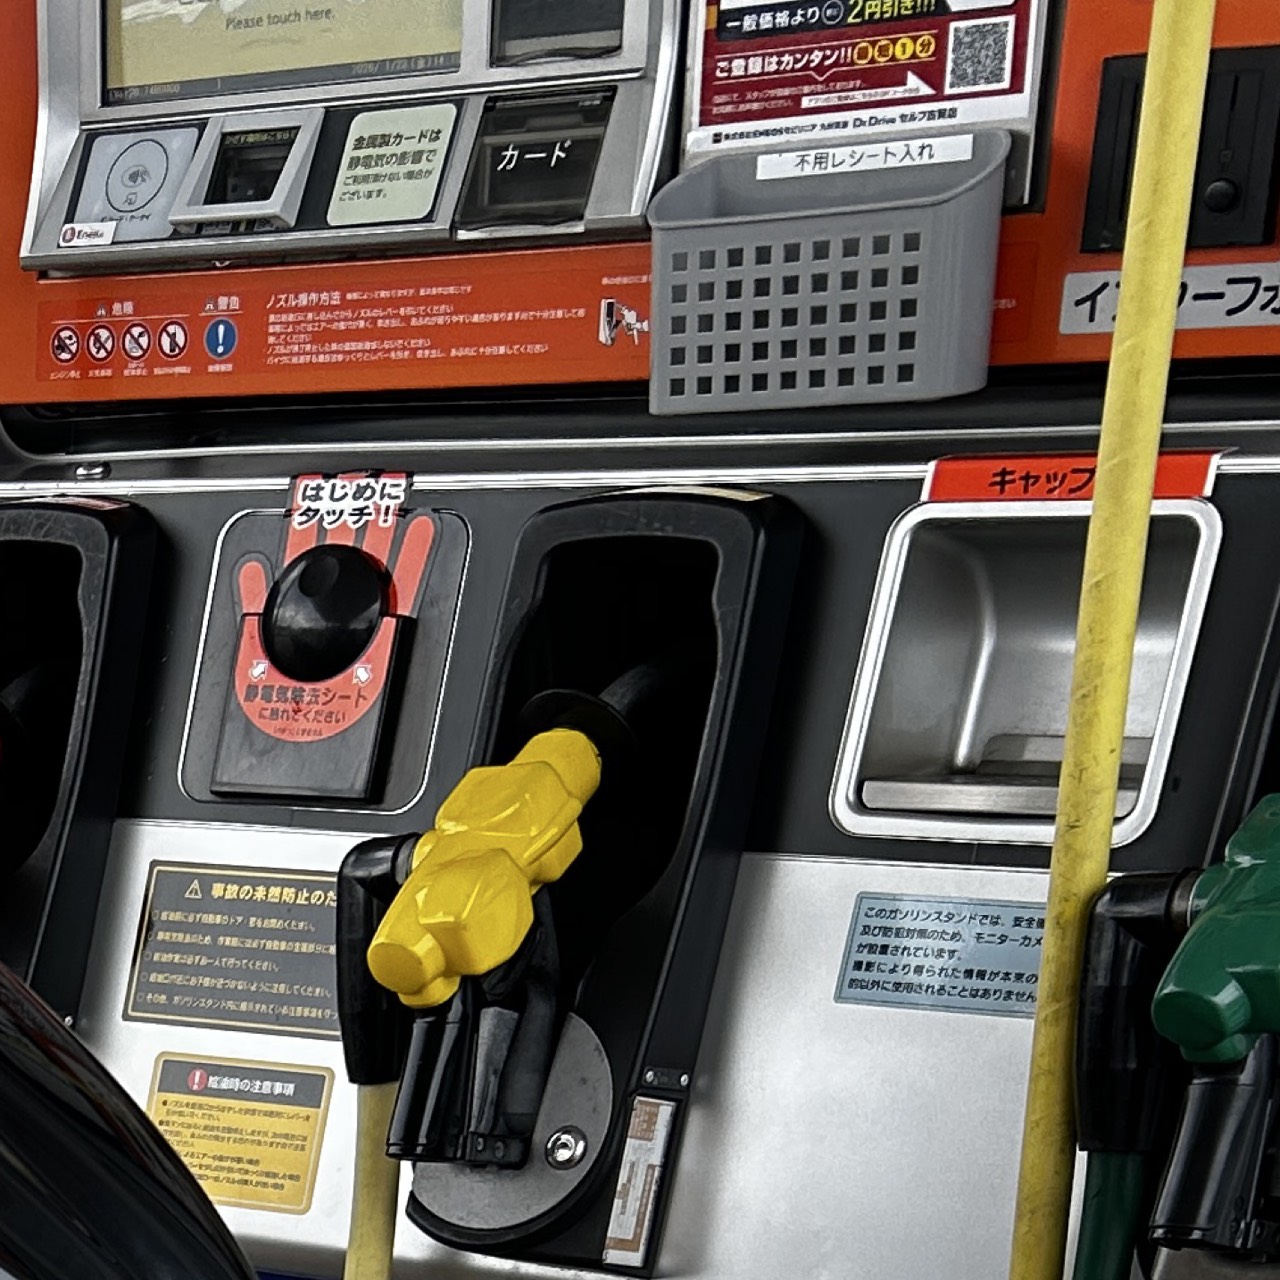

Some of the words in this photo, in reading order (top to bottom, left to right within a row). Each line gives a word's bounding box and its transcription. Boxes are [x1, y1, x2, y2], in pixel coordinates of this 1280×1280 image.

[225, 15, 263, 31] Please
[266, 11, 301, 27] touch
[305, 7, 334, 22] here.
[726, 8, 820, 32] 一般価格より
[496, 139, 572, 171] カード
[794, 143, 935, 172] 不用レシート入れ
[1074, 276, 1280, 323] イーフォ
[298, 480, 406, 504] はじめに
[295, 504, 393, 528] タッチ!
